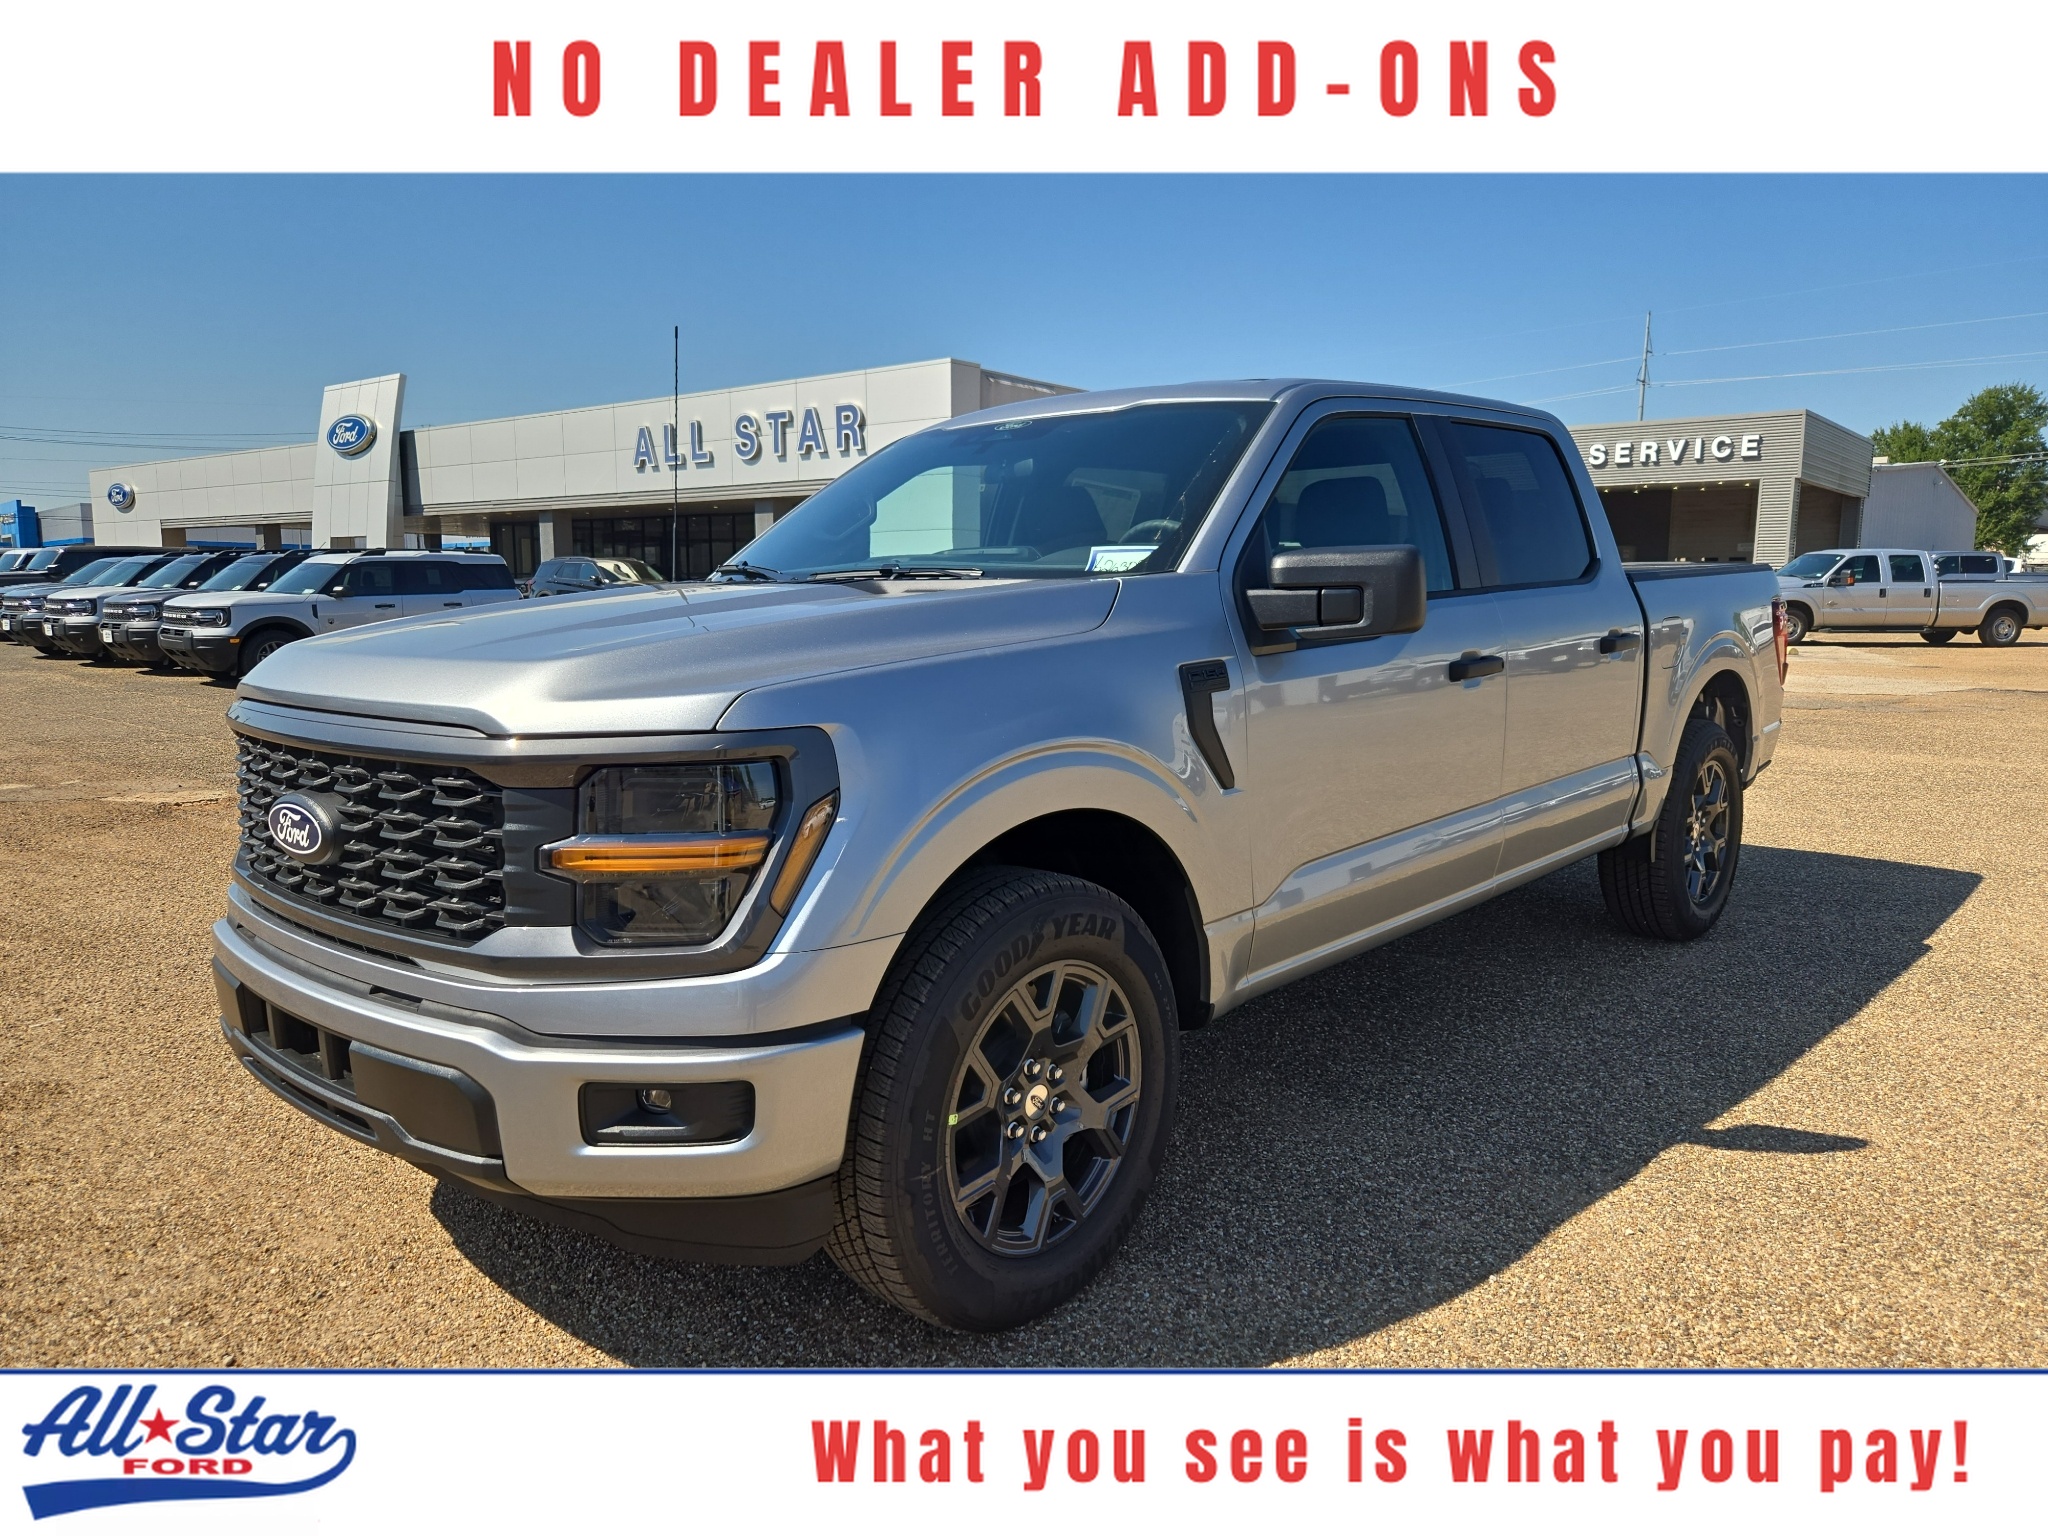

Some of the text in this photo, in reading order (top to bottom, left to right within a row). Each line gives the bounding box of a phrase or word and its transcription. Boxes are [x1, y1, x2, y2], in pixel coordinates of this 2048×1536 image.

[332, 422, 360, 445] Ford
[633, 403, 865, 468] ALL STAR
[1588, 434, 1761, 466] SERVICE
[277, 809, 310, 848] Ford
